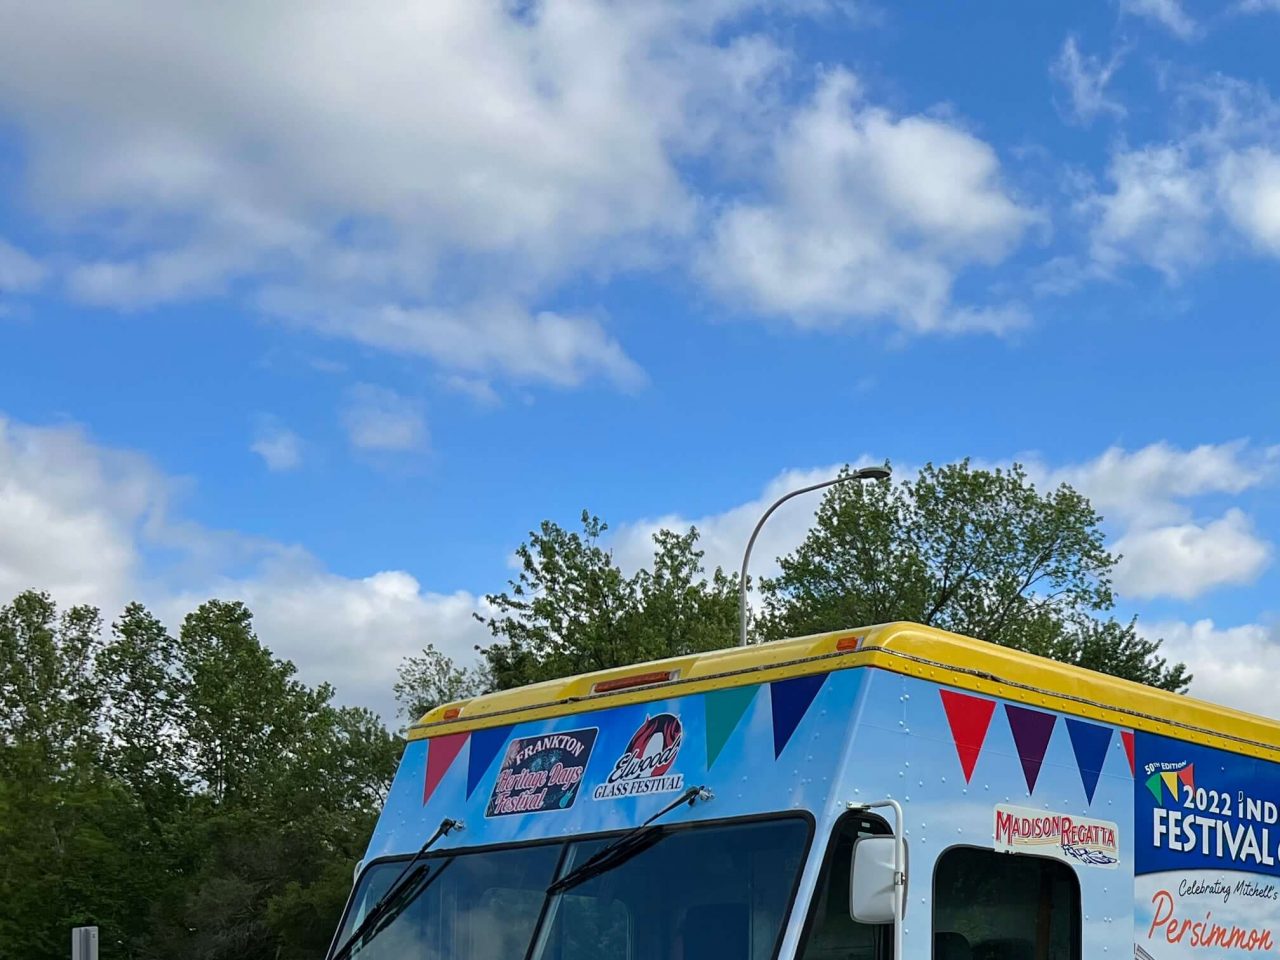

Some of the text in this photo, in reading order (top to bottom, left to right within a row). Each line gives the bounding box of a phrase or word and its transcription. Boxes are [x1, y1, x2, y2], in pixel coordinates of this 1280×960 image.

[515, 735, 585, 766] FRANKTON
[608, 735, 682, 783] Elwood
[1161, 760, 1187, 770] EDITION
[497, 763, 584, 793] Heritage Days
[594, 776, 682, 799] GLASS FESTIVAL
[495, 788, 547, 814] Festival
[1183, 784, 1232, 816] 2022
[1153, 807, 1274, 867] FESTIVAL
[1178, 879, 1231, 903] Celebrating
[1234, 880, 1278, 900] Mitchell's
[1148, 890, 1273, 951] Persimmon
